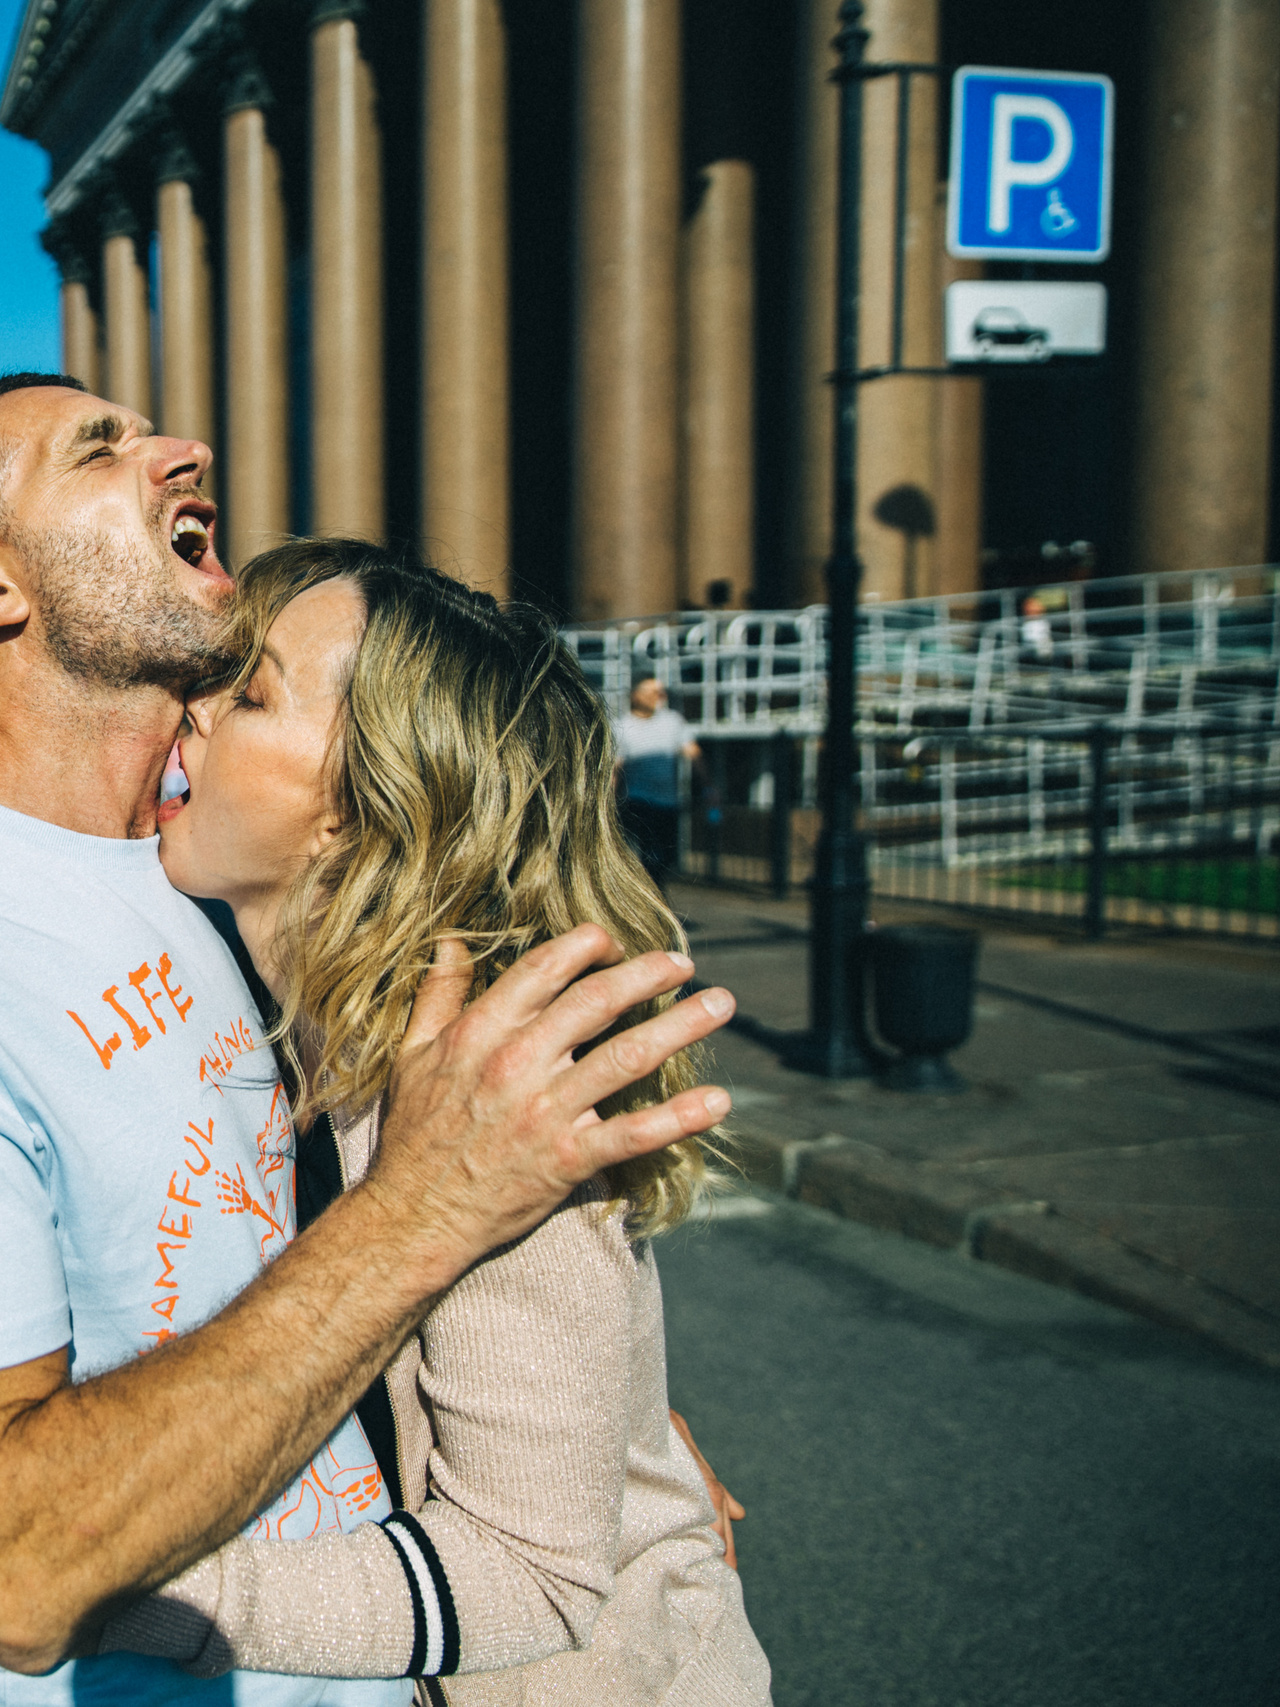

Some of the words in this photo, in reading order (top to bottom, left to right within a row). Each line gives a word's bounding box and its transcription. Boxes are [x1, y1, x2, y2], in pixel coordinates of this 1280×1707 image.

[988, 94, 1073, 233] P
[66, 952, 194, 1070] LIFE
[199, 1016, 255, 1097] THING
[138, 1117, 214, 1356] HAMEFUL
